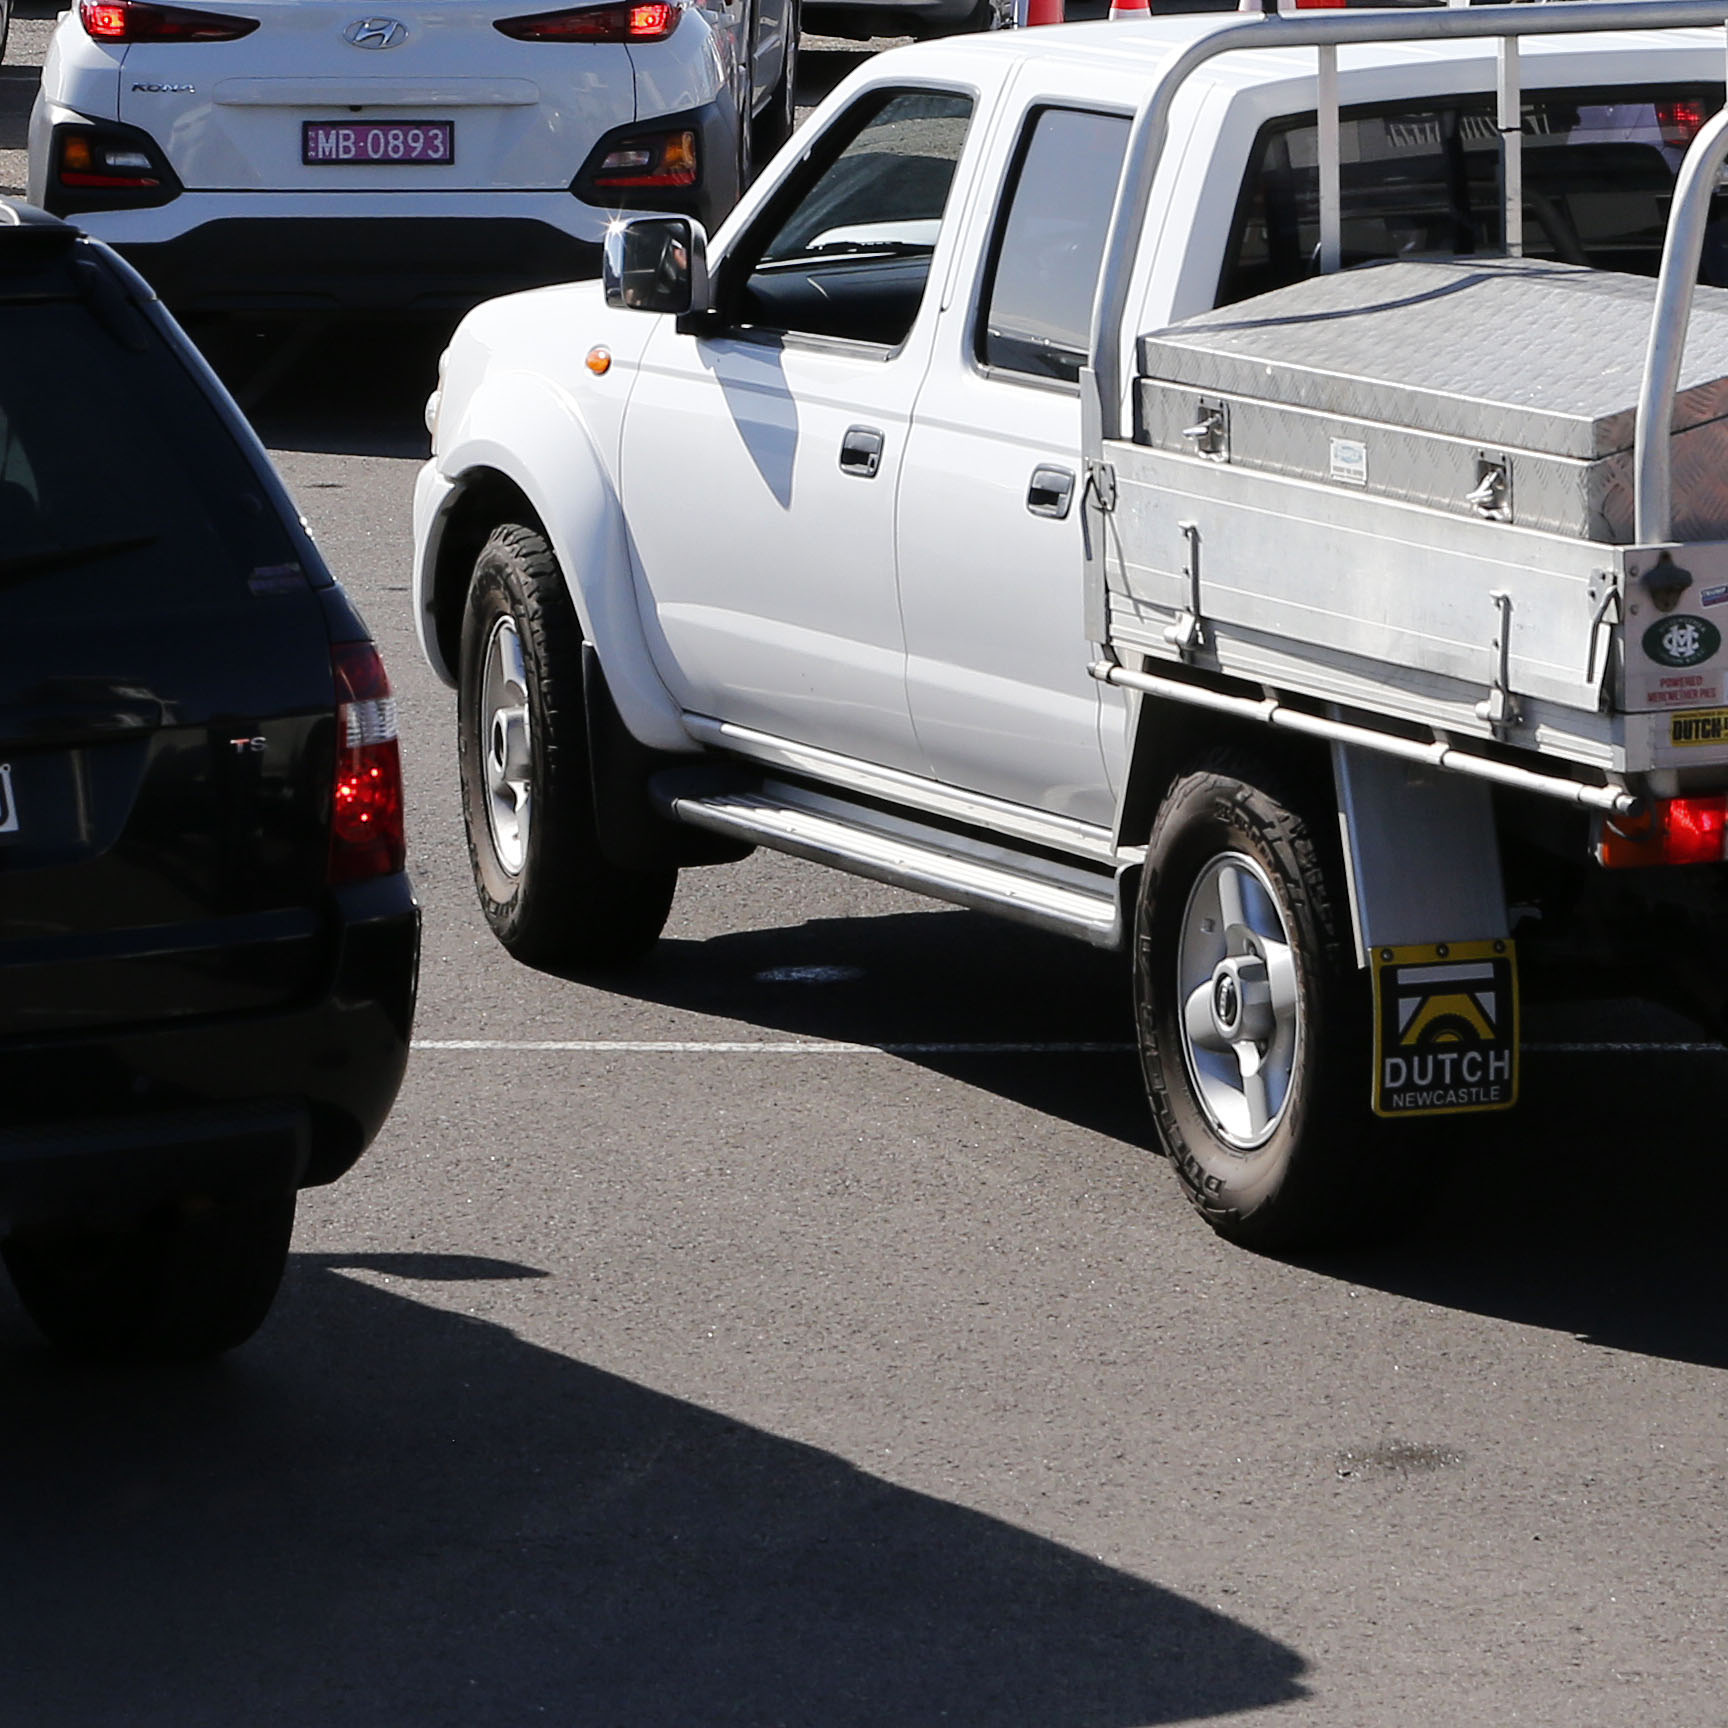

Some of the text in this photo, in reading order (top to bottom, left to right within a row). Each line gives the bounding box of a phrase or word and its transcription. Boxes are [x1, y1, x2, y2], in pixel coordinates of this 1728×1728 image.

[132, 84, 195, 94] KONA
[1673, 718, 1722, 741] DUTCH
[230, 737, 267, 754] TS
[1385, 1049, 1509, 1088] DUTCH
[1392, 1086, 1501, 1108] NEWCASTLE
